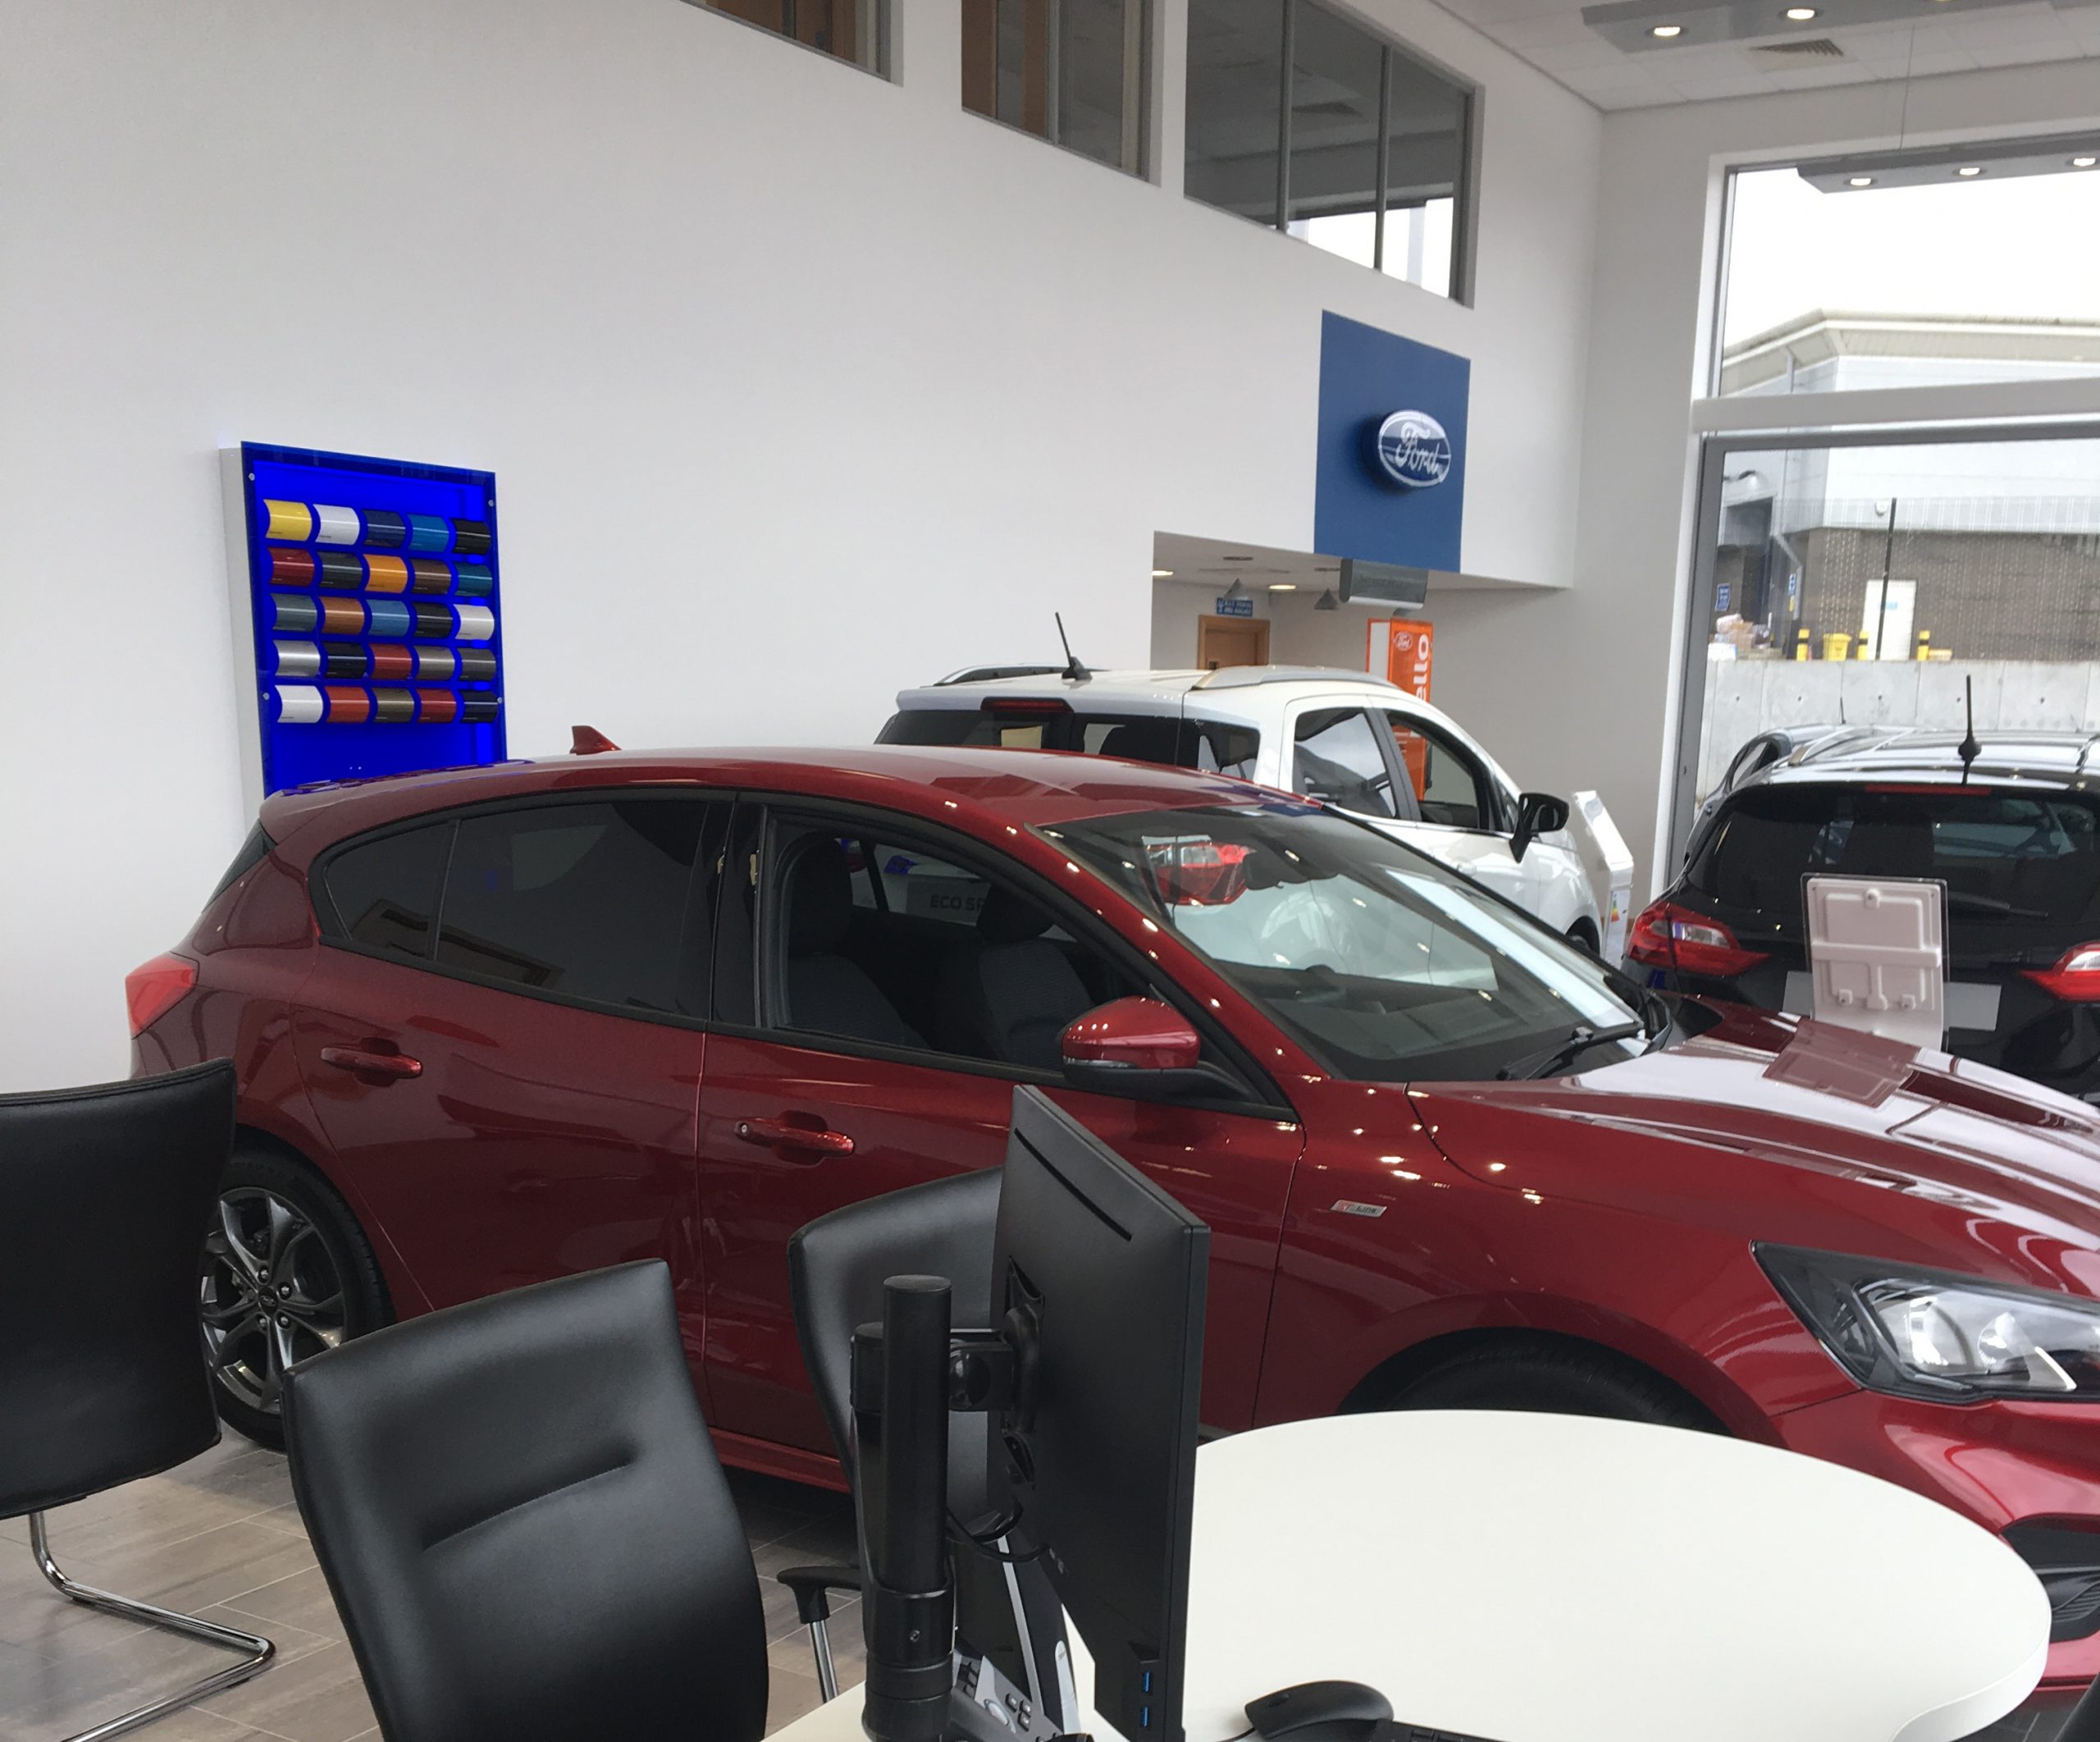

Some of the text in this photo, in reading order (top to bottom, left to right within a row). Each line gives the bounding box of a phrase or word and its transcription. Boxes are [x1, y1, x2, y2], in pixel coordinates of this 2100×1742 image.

[1395, 422, 1440, 476] Ford
[1413, 633, 1429, 703] ello
[931, 894, 985, 912] ECO SP
